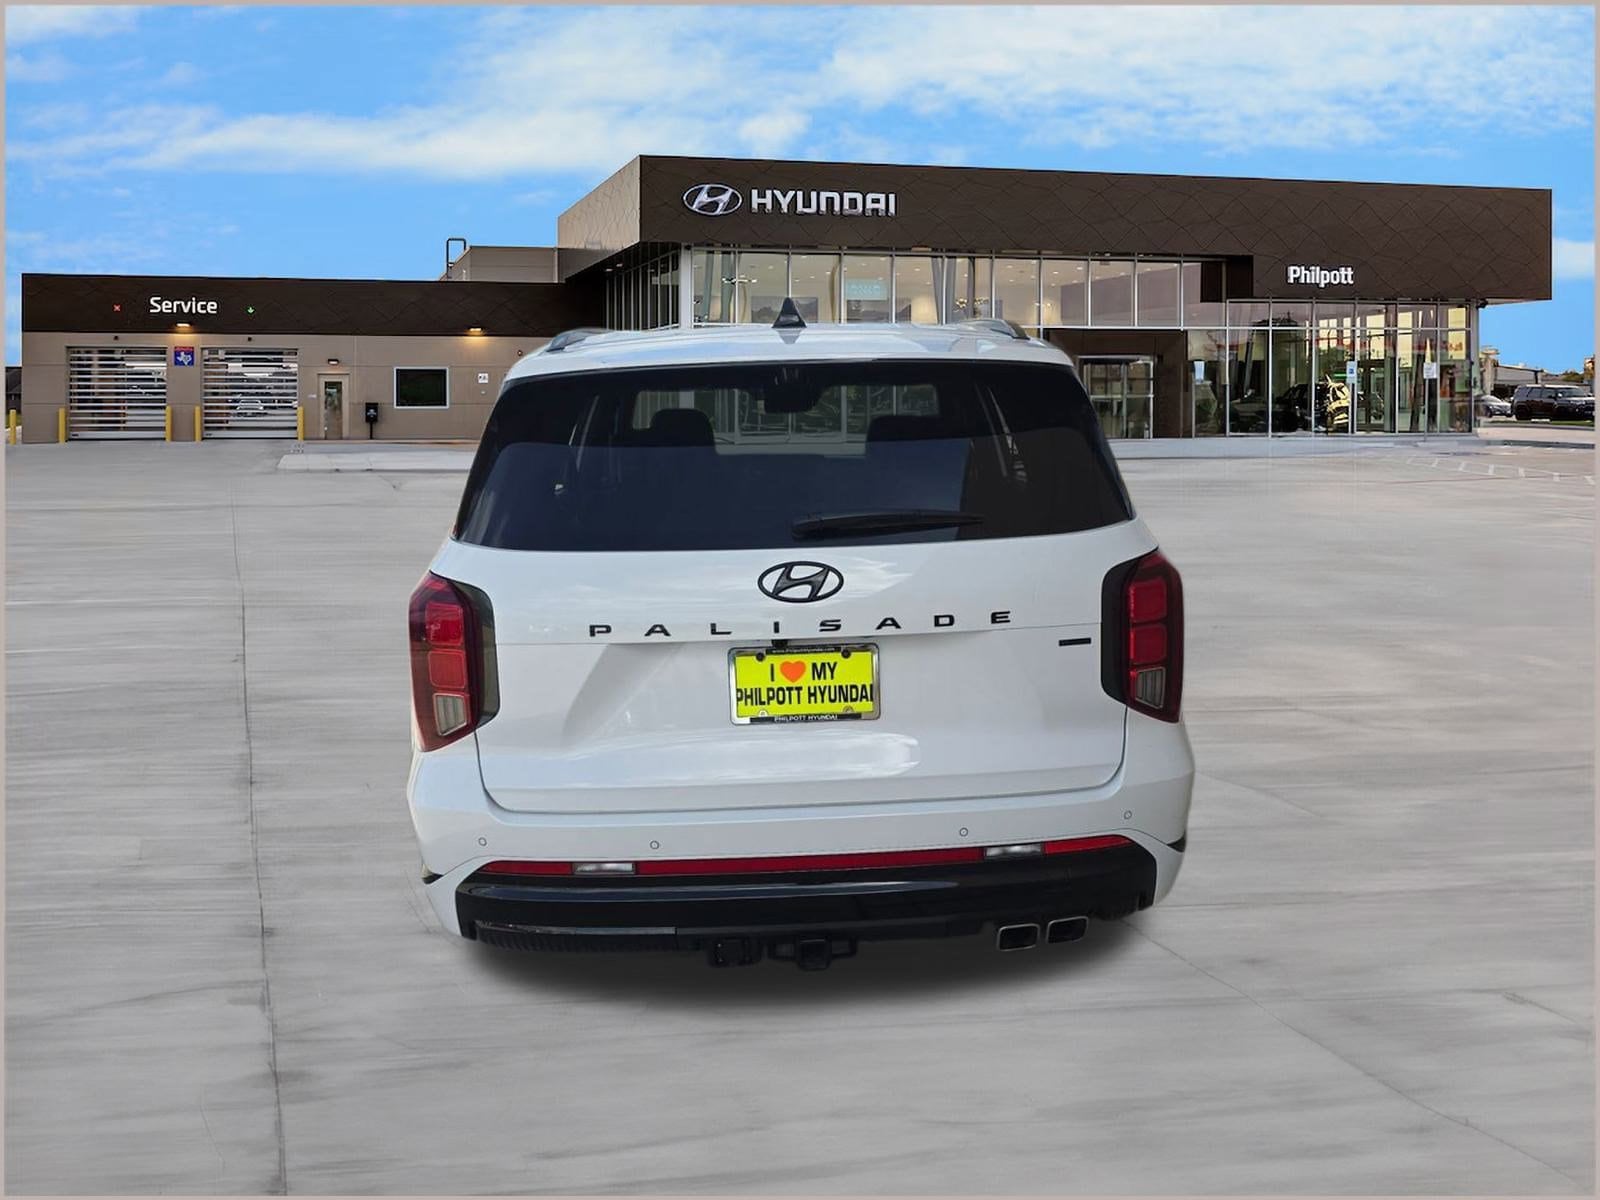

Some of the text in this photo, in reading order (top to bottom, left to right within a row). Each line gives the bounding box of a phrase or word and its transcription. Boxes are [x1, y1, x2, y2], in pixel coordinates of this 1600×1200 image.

[752, 189, 896, 216] HYUNDAI
[1287, 265, 1354, 288] Philpott
[149, 297, 218, 314] Service
[589, 610, 1012, 637] PALISADE
[770, 661, 838, 682] I MY
[736, 685, 803, 706] PHILPOTT
[774, 713, 838, 723] PHILPOTT HYUNDAI
